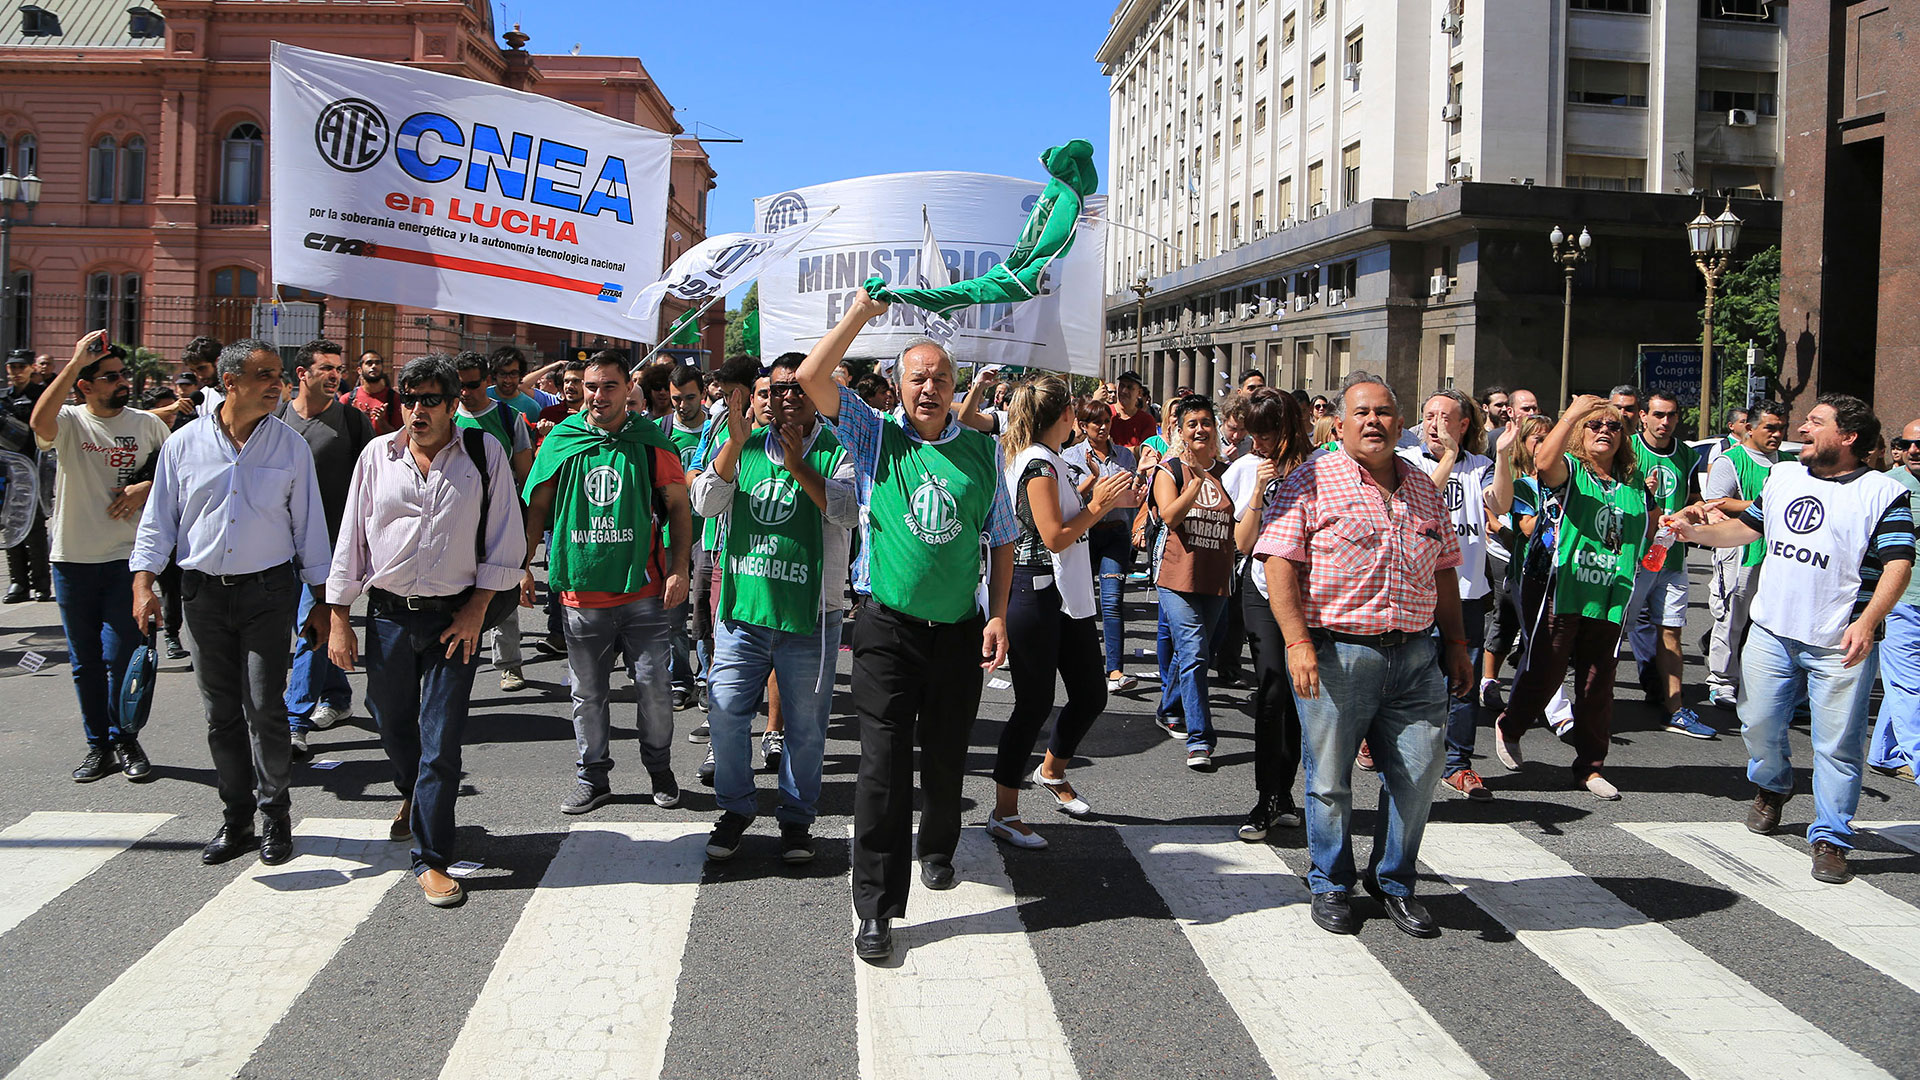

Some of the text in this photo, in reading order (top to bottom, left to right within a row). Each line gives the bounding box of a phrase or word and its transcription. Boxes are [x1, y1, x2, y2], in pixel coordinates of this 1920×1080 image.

[320, 103, 382, 167] ATE
[394, 111, 634, 225] CNEA
[385, 192, 579, 245] en LUCHA
[303, 231, 369, 257] CTA
[309, 207, 626, 272] por la soberanía energética y la autonomía tecnologica nacional
[1655, 365, 1702, 377] Congres
[1658, 379, 1702, 389] Naciona
[110, 453, 136, 467] 87
[587, 469, 617, 503] ATE
[752, 481, 793, 521] ATE
[590, 516, 615, 531] VIAS
[912, 485, 955, 531] ATE
[1788, 499, 1821, 531] ATE
[571, 528, 634, 544] NAVEGABLES
[902, 512, 963, 545] NAVEGABLES
[749, 534, 778, 557] VIAS
[728, 554, 809, 585] NAVEGABLES
